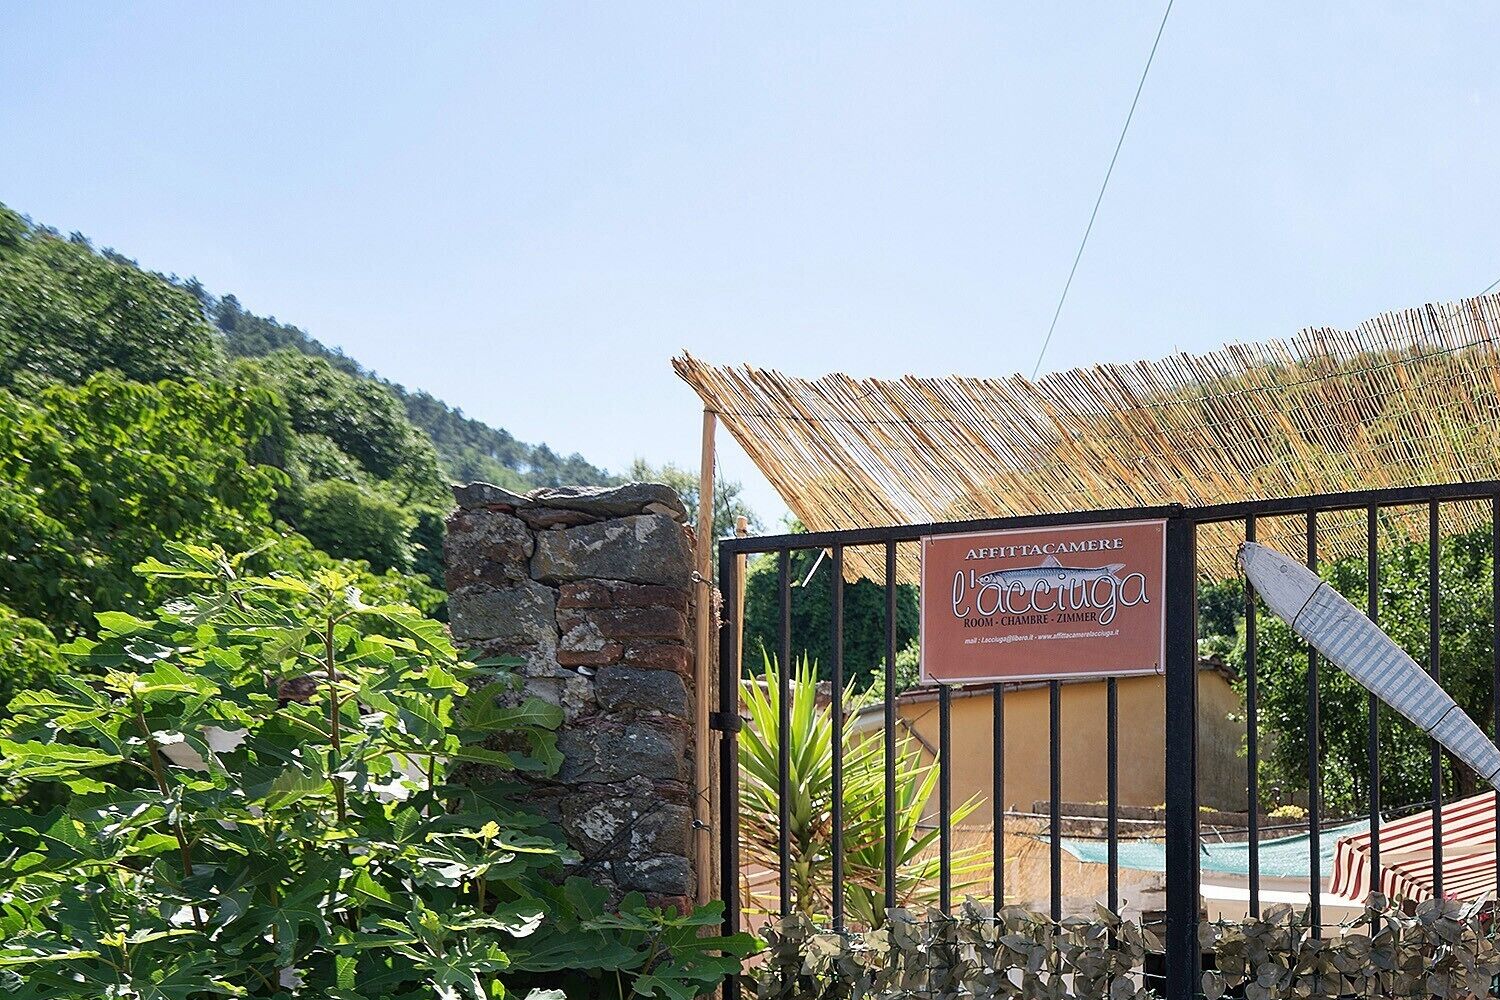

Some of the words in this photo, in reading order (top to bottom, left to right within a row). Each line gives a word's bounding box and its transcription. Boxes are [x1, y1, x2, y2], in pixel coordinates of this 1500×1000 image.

[964, 537, 1125, 561] AFFITTACAMERE
[951, 569, 1150, 626] l'acciuga
[964, 618, 994, 628] ROOM
[1000, 614, 1049, 627] CHAMBRE
[1056, 611, 1097, 623] ZIMMER
